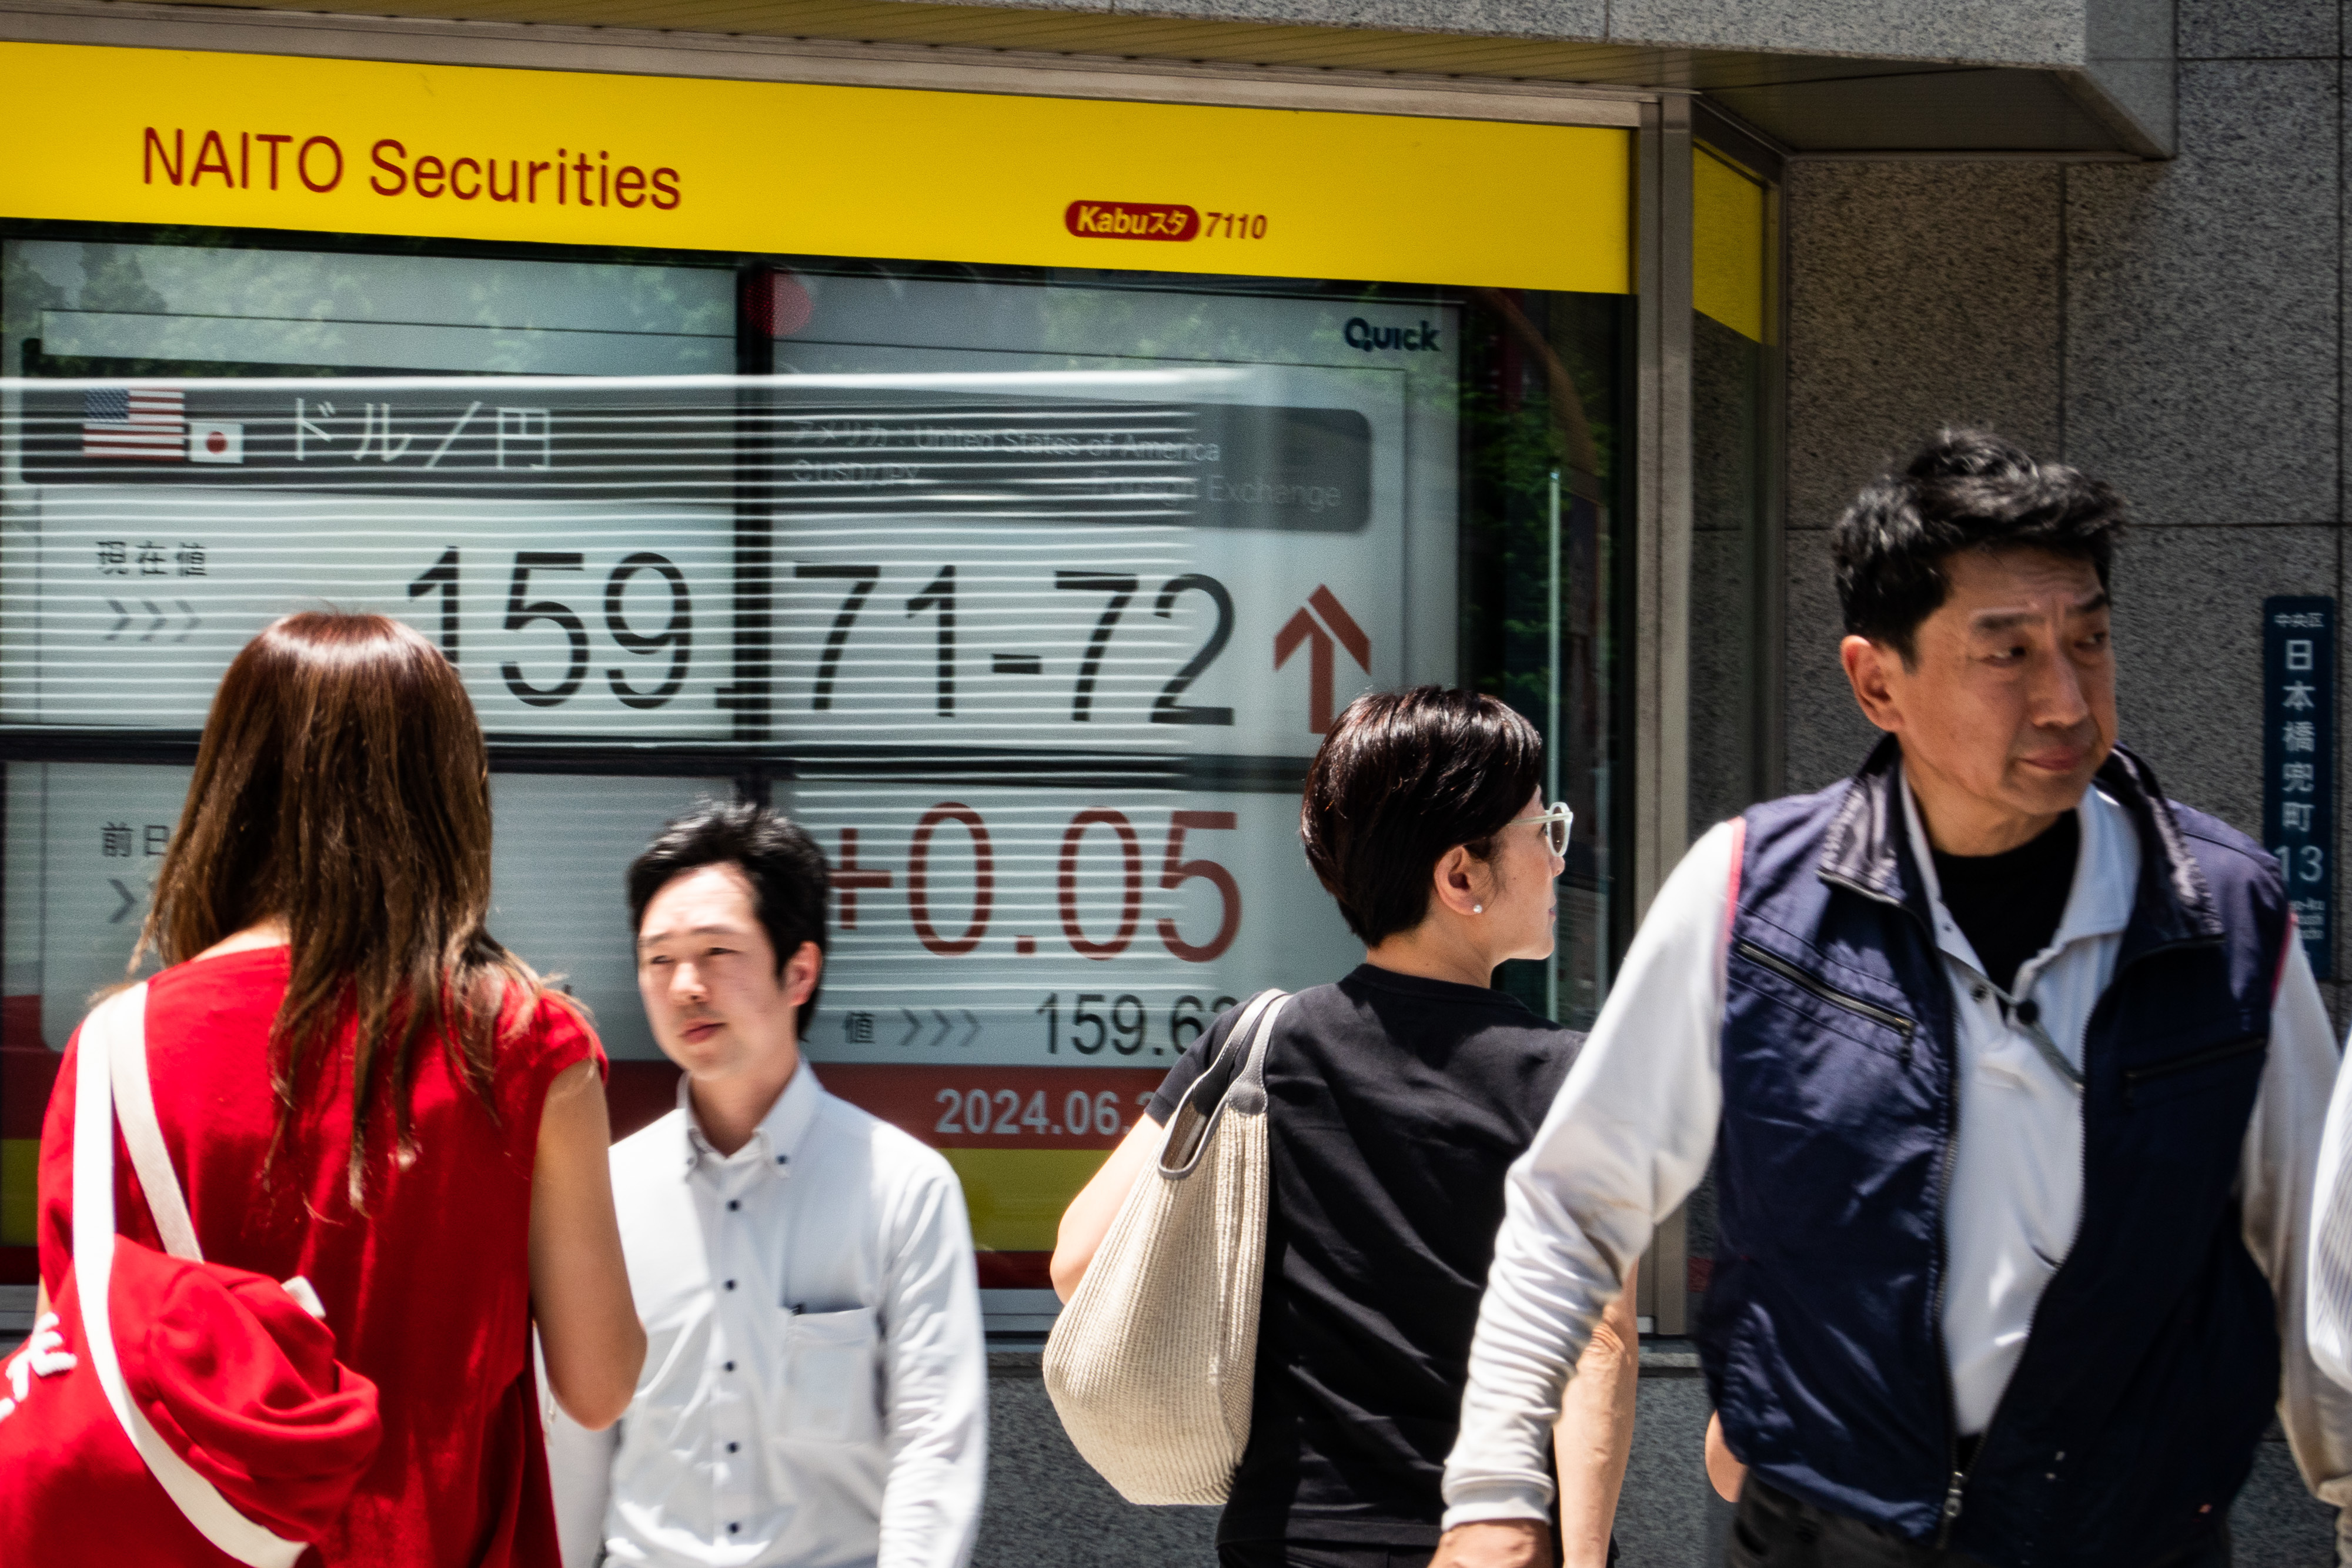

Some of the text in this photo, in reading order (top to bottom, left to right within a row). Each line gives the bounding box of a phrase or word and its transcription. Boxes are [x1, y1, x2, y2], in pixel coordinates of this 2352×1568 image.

[142, 126, 682, 210] NAITO Securities
[1076, 205, 1268, 239] Kabuスタ 7110
[913, 423, 994, 453] United
[1001, 428, 1081, 457] States
[1088, 433, 1114, 457] of
[1120, 434, 1220, 462] America
[1210, 474, 1342, 513] Exchange
[95, 540, 207, 576] 現在値
[2281, 638, 2316, 833] 日本橋兜町
[2274, 845, 2324, 882] 13
[1037, 992, 1238, 1057] 159.6
[935, 1088, 1156, 1136] 2024.06.
